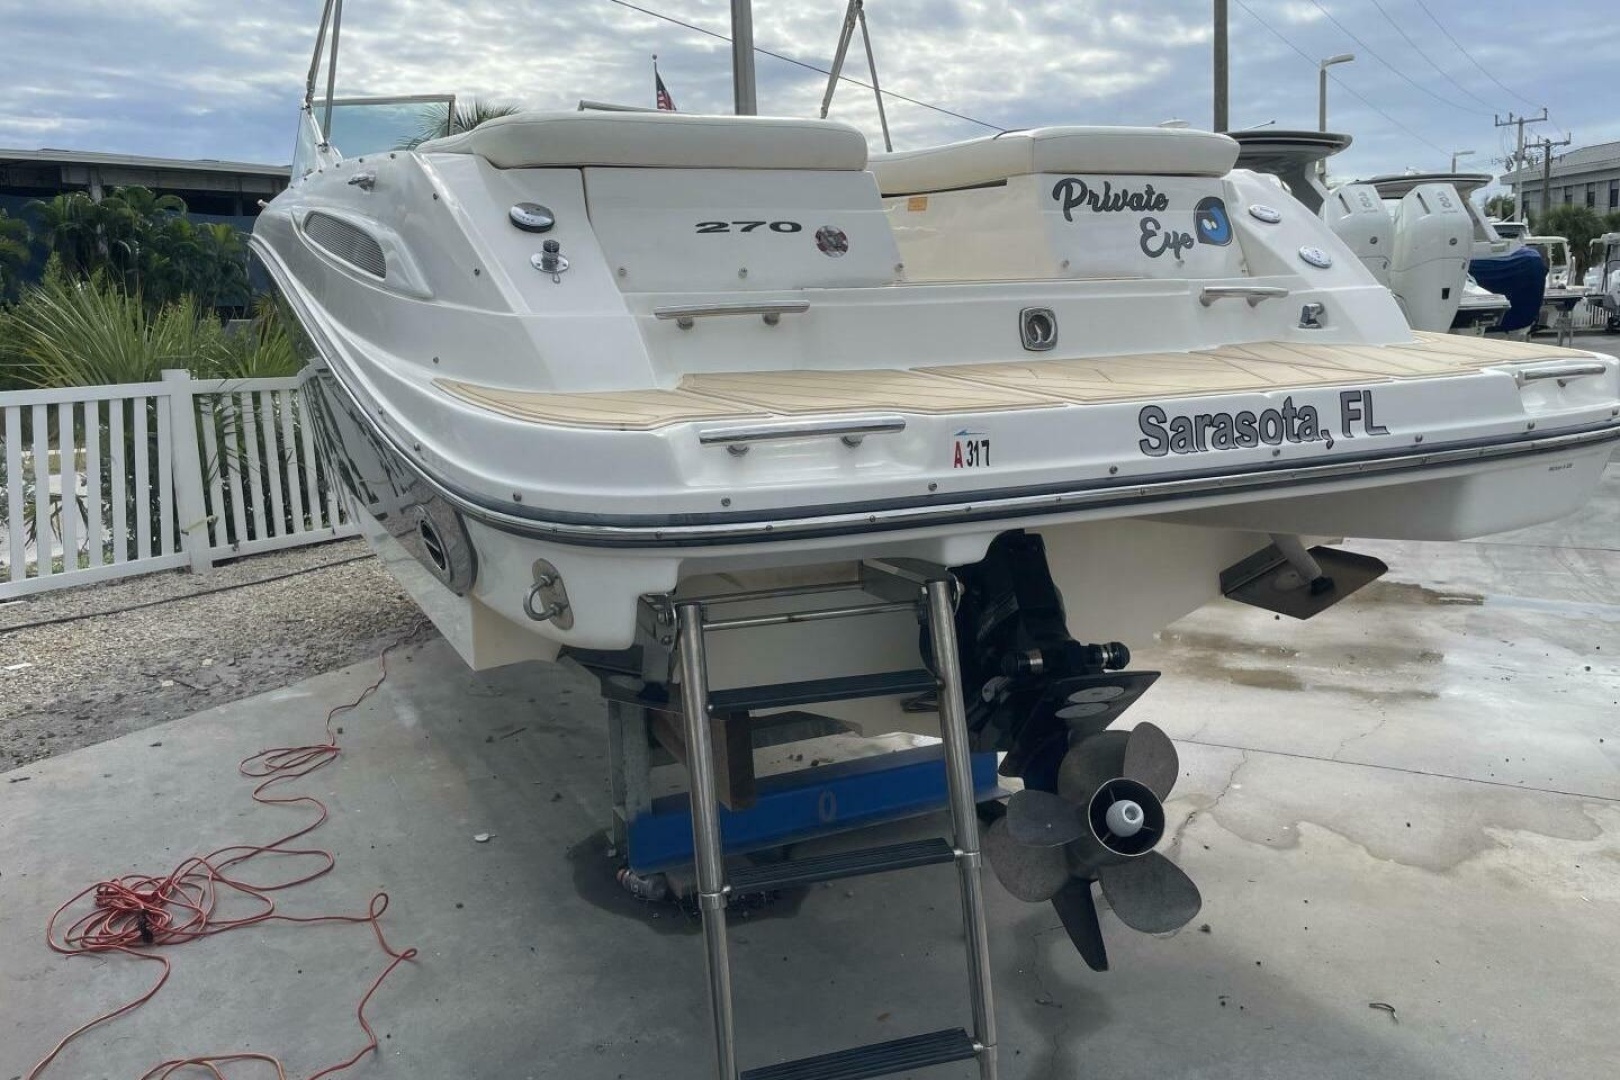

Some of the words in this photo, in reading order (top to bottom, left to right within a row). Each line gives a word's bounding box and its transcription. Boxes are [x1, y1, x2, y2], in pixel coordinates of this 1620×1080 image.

[1052, 177, 1169, 222] Private
[695, 221, 802, 233] 270
[1139, 216, 1194, 259] Eye
[1138, 396, 1334, 457] Sarasota,
[1339, 390, 1390, 438] FL
